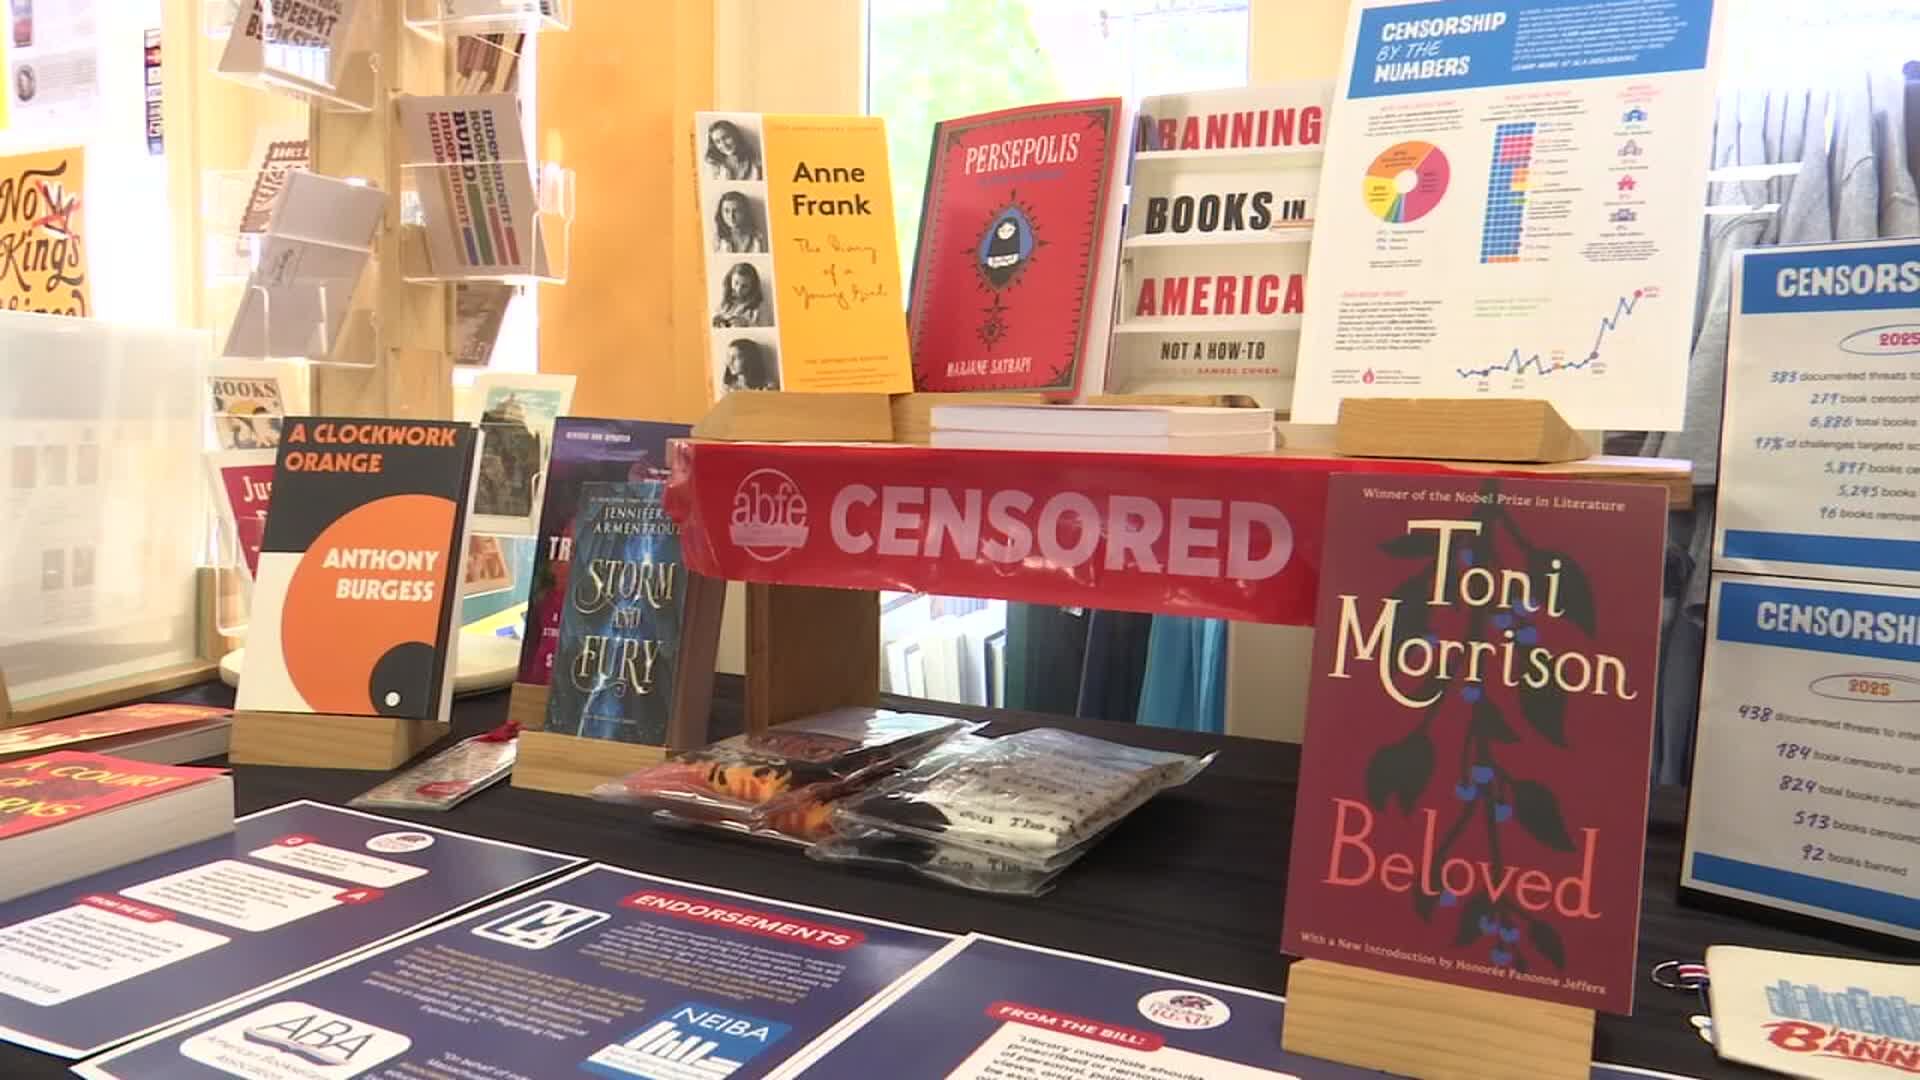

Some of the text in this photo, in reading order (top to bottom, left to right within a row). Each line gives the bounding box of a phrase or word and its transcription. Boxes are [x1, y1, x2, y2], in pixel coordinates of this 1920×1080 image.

[1381, 11, 1507, 42] CENSORSHIP
[1376, 40, 1443, 62] BY THE
[1374, 55, 1471, 84] NUMBERS
[1156, 105, 1323, 151] BANNING
[451, 110, 477, 183] BUILD
[965, 132, 1081, 176] PERSEPOLIS
[792, 161, 866, 183] Anne
[0, 160, 67, 224] No
[791, 193, 872, 216] Frank
[1145, 191, 1307, 234] BOOKS IN
[0, 227, 85, 293] Kings
[1135, 273, 1305, 317] AMERICA
[1160, 340, 1266, 361] NOT A HOW-TO
[213, 381, 278, 399] BOOKS
[288, 423, 457, 447] A CLOCKWORK
[285, 452, 384, 473] ORANGE
[602, 505, 664, 520] JENNIFER
[1362, 486, 1627, 513] Winner of the Nobel Prize in Literature
[731, 482, 1295, 582] abfe CENSORED
[322, 547, 440, 573] ANTHONY
[1406, 519, 1567, 618] Toni
[335, 578, 435, 602] BURGESS
[575, 557, 678, 612] STORM
[572, 635, 664, 695] FURY
[1327, 593, 1638, 709] Morrison
[1848, 678, 1891, 697] 2025
[1776, 743, 1812, 760] 184
[1779, 775, 1818, 794] 824
[1793, 810, 1831, 829] 513
[1320, 797, 1602, 920] Beloved
[1802, 843, 1825, 862] 92
[632, 894, 851, 947] ENDORSEMENTS
[1300, 931, 1326, 946] With
[1337, 937, 1361, 952] New
[1363, 942, 1437, 966] Introduction
[1439, 955, 1453, 970] by
[1562, 976, 1607, 995] Jeffers
[254, 1013, 377, 1061] ABA
[671, 1007, 770, 1043] NEIBA
[999, 1006, 1147, 1046] FROM THE BILL:
